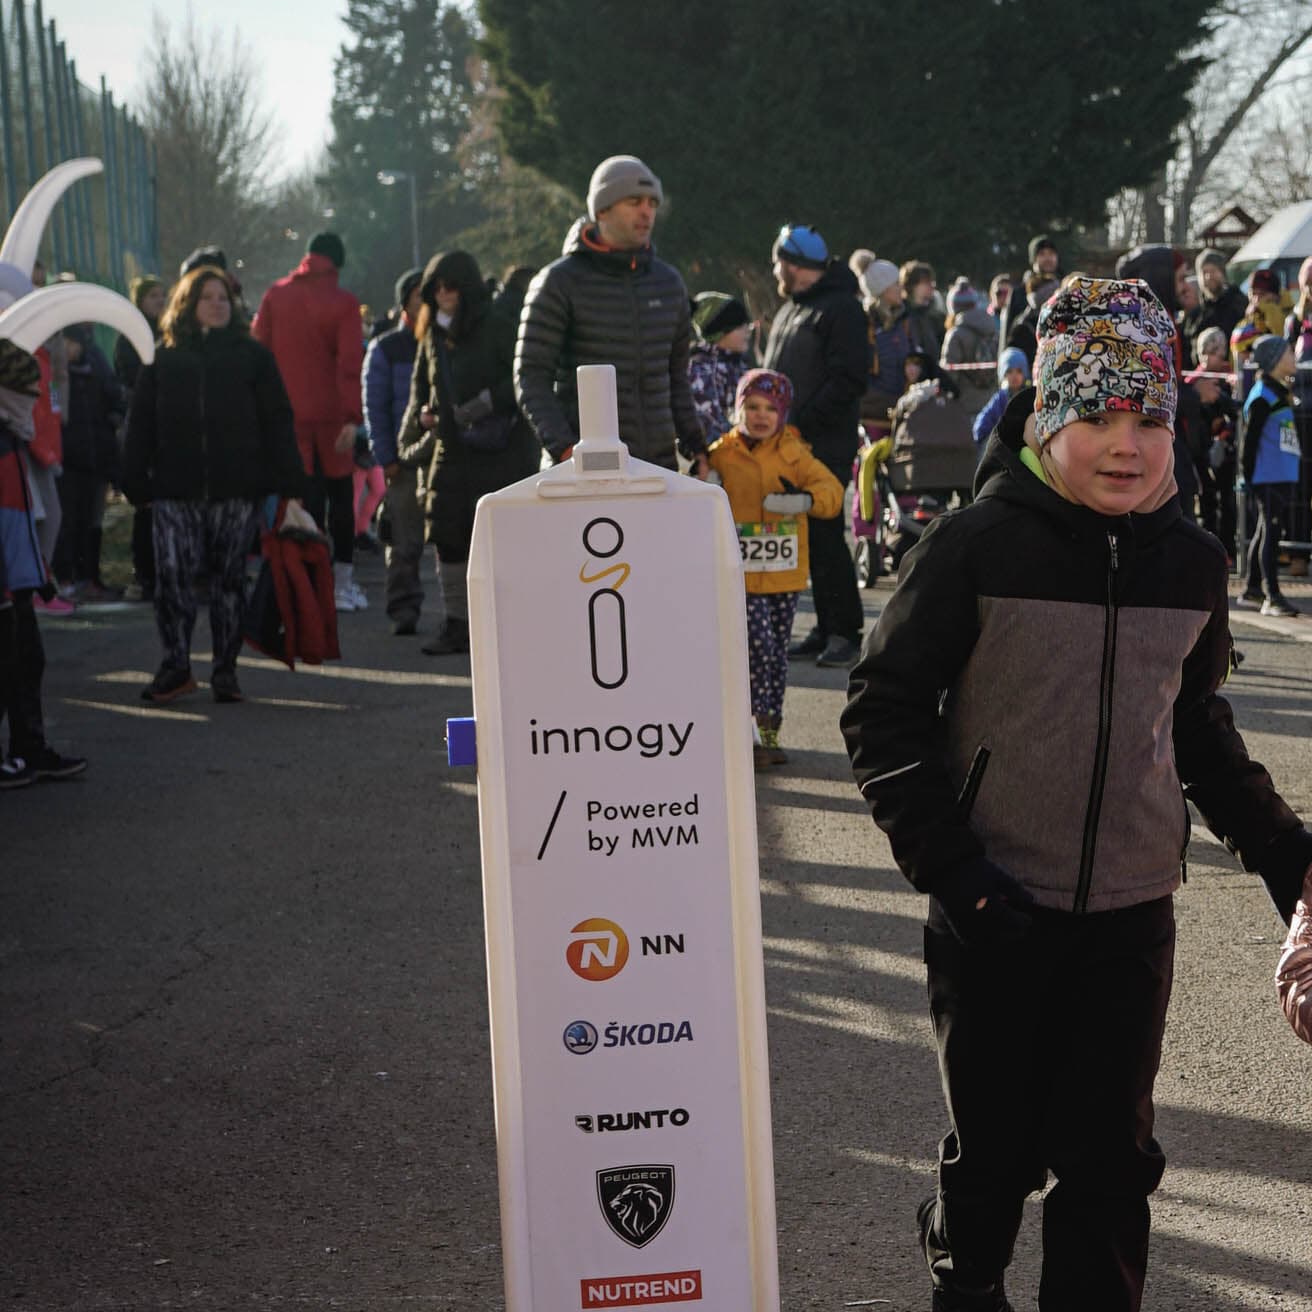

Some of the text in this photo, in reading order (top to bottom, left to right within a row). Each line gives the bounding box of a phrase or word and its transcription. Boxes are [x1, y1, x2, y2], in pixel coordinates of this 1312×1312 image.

[530, 719, 695, 758] innogy
[587, 794, 700, 822] Powered
[588, 824, 700, 857] by MVM
[640, 934, 685, 956] NN
[603, 1021, 694, 1048] ŠKODA
[598, 1108, 690, 1133] RUNTO
[603, 1171, 668, 1184] PEUGEOT
[588, 1276, 697, 1302] NUTREND
